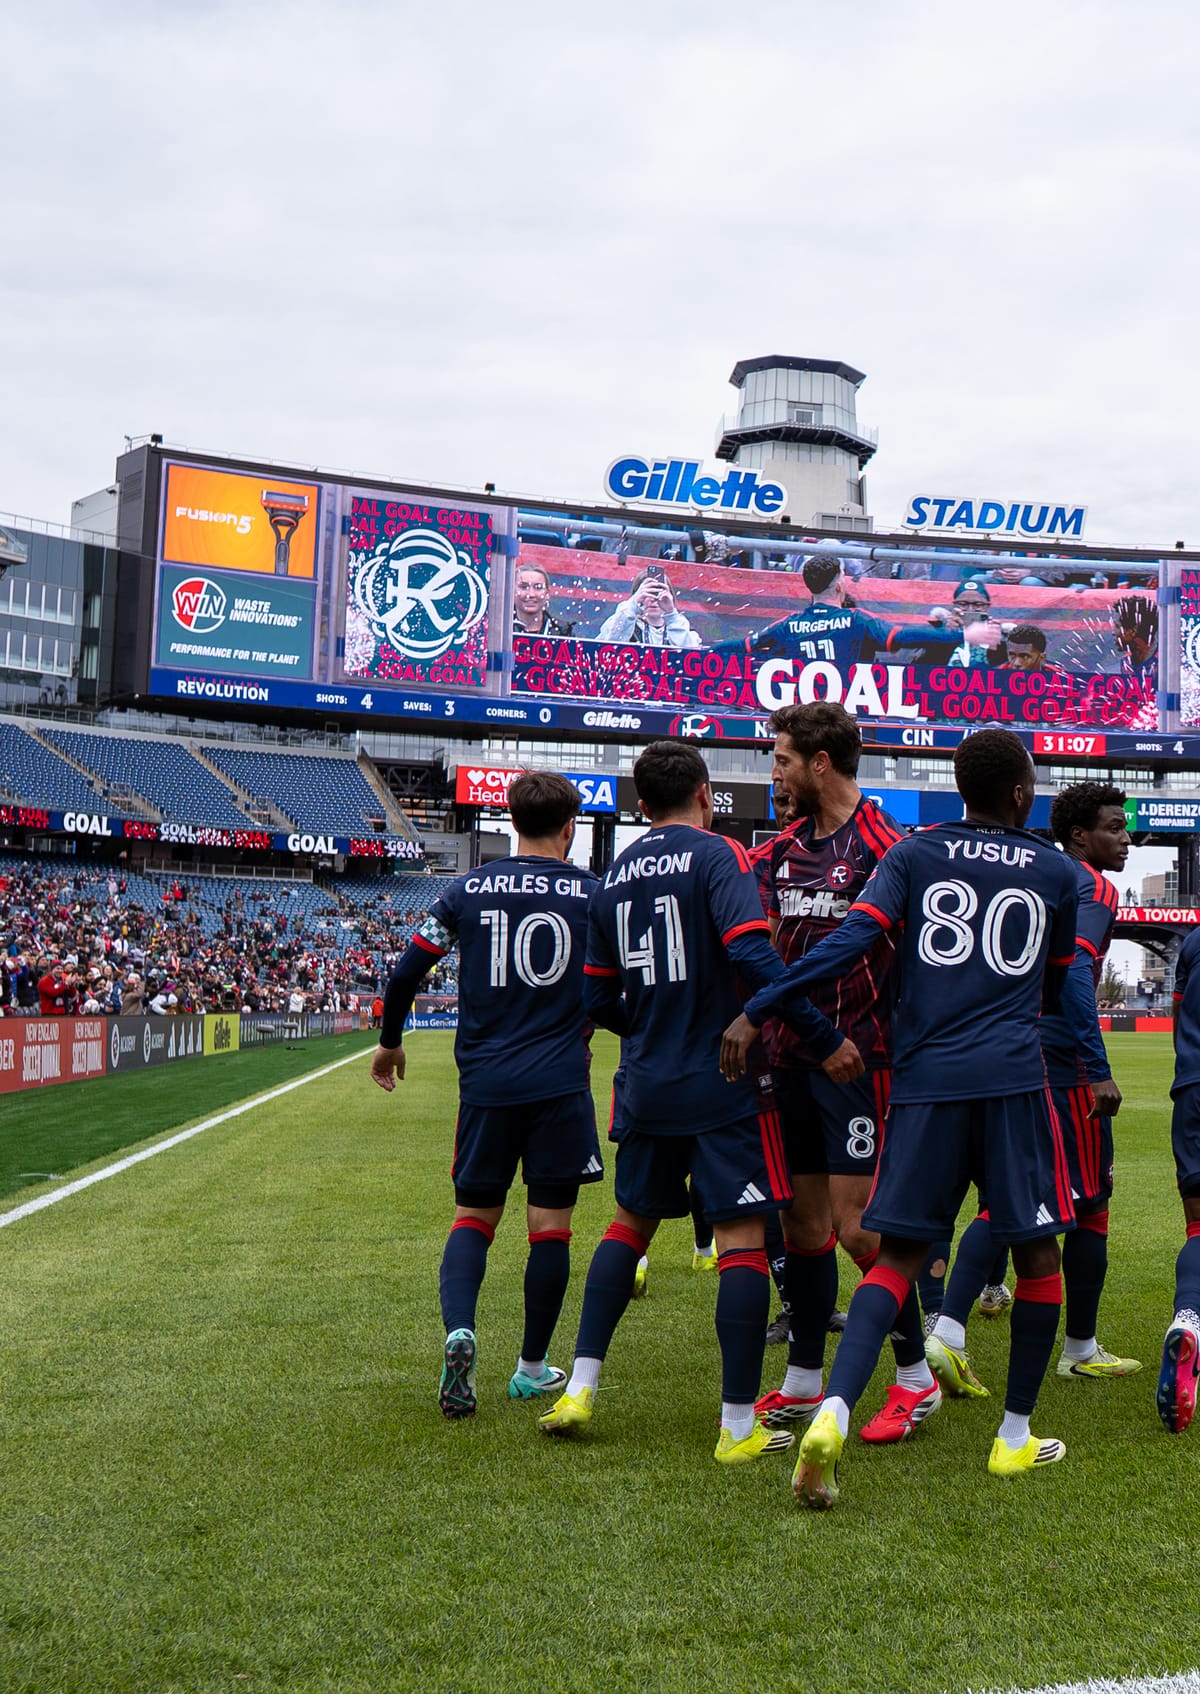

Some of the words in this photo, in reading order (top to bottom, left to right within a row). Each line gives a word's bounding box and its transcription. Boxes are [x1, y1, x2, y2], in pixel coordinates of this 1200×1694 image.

[607, 457, 785, 514] Gillette
[385, 503, 433, 524] GOAL
[437, 509, 484, 530] GOAL
[906, 496, 1085, 536] STADIUM
[234, 598, 272, 614] WASTE
[229, 609, 299, 628] INNOVATIONS
[788, 617, 851, 634] TURGEMAN
[170, 642, 232, 659] PERFORMANCE
[233, 649, 250, 661] FOR
[251, 651, 267, 663] THE
[267, 653, 300, 665] PLANET
[513, 638, 591, 669] GOAL
[598, 645, 676, 675] GOAL
[683, 651, 758, 681] GOAL
[800, 639, 836, 660] 11
[378, 662, 426, 682] GOAL
[429, 666, 477, 686] GOAL
[928, 667, 1002, 695] GOAL
[1008, 671, 1081, 698] GOAL
[177, 680, 269, 702] REVOLUTION
[526, 666, 605, 698] GOAL
[612, 673, 690, 703] GOAL
[697, 679, 762, 709] GOA
[756, 658, 920, 719] GOAL
[316, 692, 348, 706] SHOTS:
[361, 693, 374, 710] 4
[403, 701, 433, 712] SAVES:
[444, 700, 455, 716] 3
[942, 693, 1016, 721] GOAL
[1022, 697, 1095, 723] GOAL
[486, 708, 527, 719] CORNERS:
[539, 708, 552, 723] 0
[582, 711, 642, 730] Gillette
[902, 729, 934, 746] CIN
[1043, 736, 1096, 753] 31:07
[1136, 743, 1163, 752] SHOTS:
[1173, 741, 1184, 755] 4
[468, 786, 509, 804] Heal
[63, 812, 112, 837] GOAL
[287, 834, 338, 854] GOAL
[1149, 818, 1195, 828] COMPANIES
[944, 839, 1036, 868] YUSUF
[604, 851, 693, 890] LANGONI
[464, 875, 549, 895] CARLES
[555, 878, 588, 898] GIL
[917, 877, 1047, 977] 80
[1143, 908, 1198, 923] TOYOTA
[480, 909, 572, 988] 10
[616, 894, 687, 986] 41
[846, 1114, 876, 1160] 8
